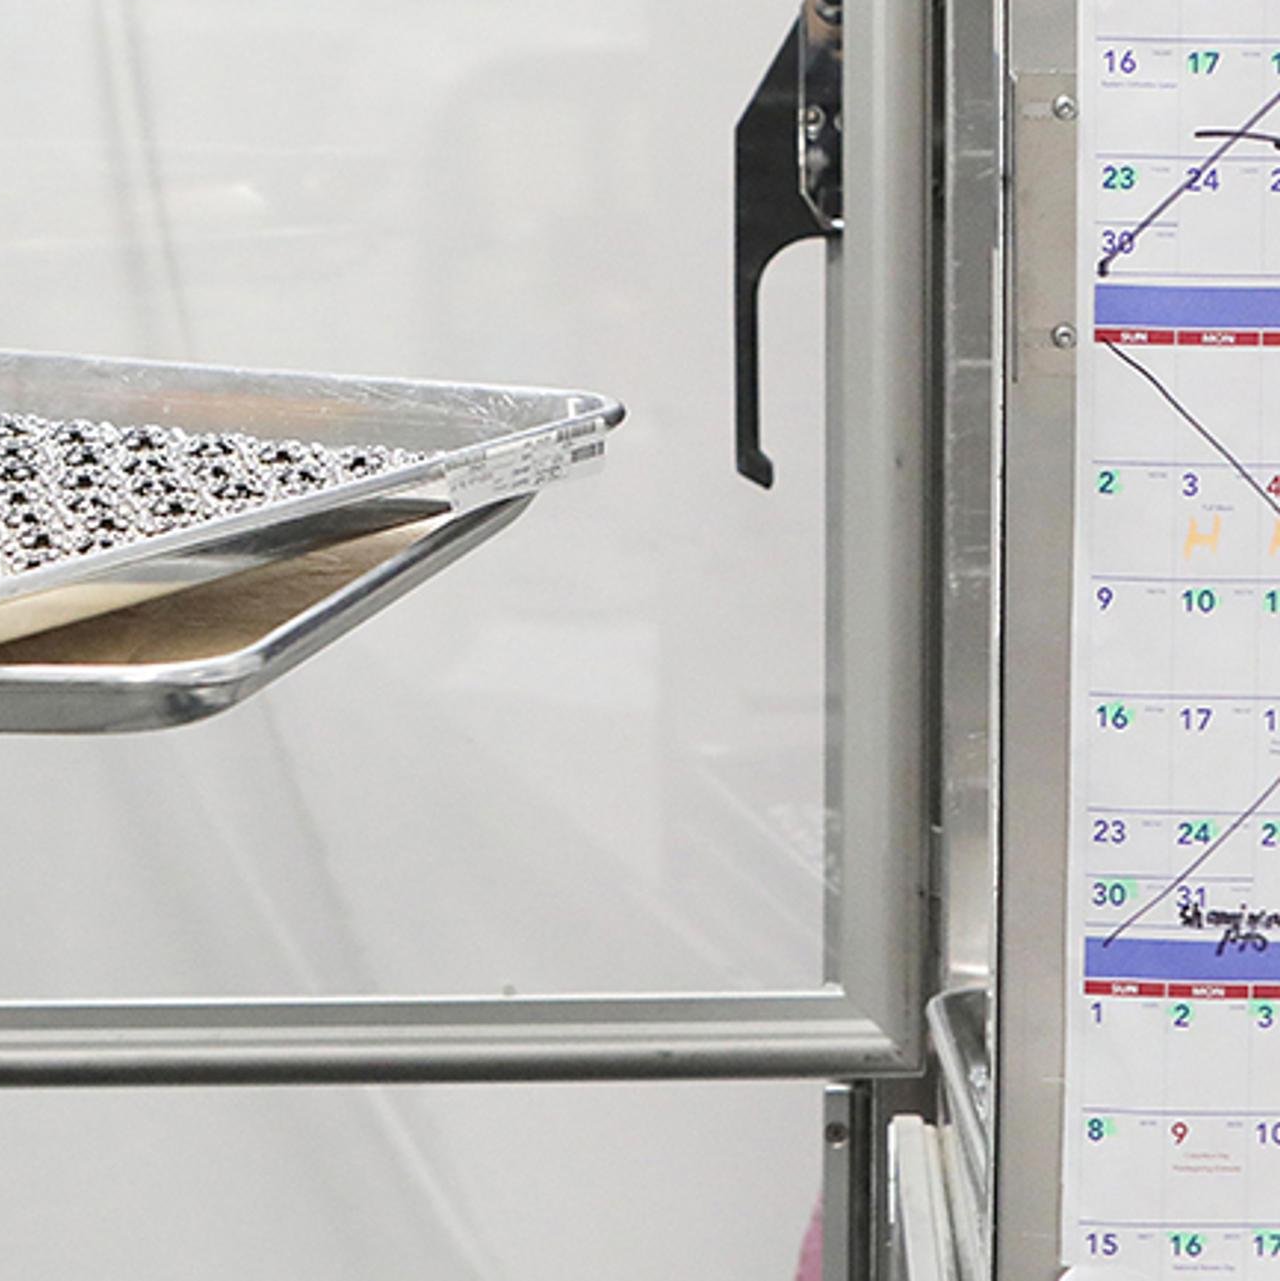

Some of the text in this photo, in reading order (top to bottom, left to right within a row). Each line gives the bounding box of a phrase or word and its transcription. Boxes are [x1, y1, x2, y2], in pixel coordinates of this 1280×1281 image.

[1103, 50, 1137, 74] 16
[1188, 51, 1220, 74] 17
[1102, 166, 1135, 190] 23
[1185, 168, 1219, 191] 24
[1102, 231, 1135, 255] 30
[1099, 471, 1115, 494] 2
[1182, 473, 1199, 497] 3
[1096, 586, 1113, 610] 9
[1183, 589, 1216, 613] 10
[1097, 705, 1130, 730] 16
[1180, 708, 1212, 731] 17
[1093, 819, 1126, 844] 23
[1178, 822, 1211, 845] 24
[1093, 882, 1127, 907] 30
[1177, 885, 1205, 908] 31
[1091, 1002, 1102, 1023] 1
[1173, 1003, 1191, 1028] 2
[1257, 1004, 1274, 1029] 3
[1087, 1118, 1104, 1141] 8
[1171, 1121, 1188, 1145] 9
[1085, 1233, 1119, 1256] 15
[1171, 1234, 1202, 1257] 16
[1254, 1233, 1280, 1256] 17
